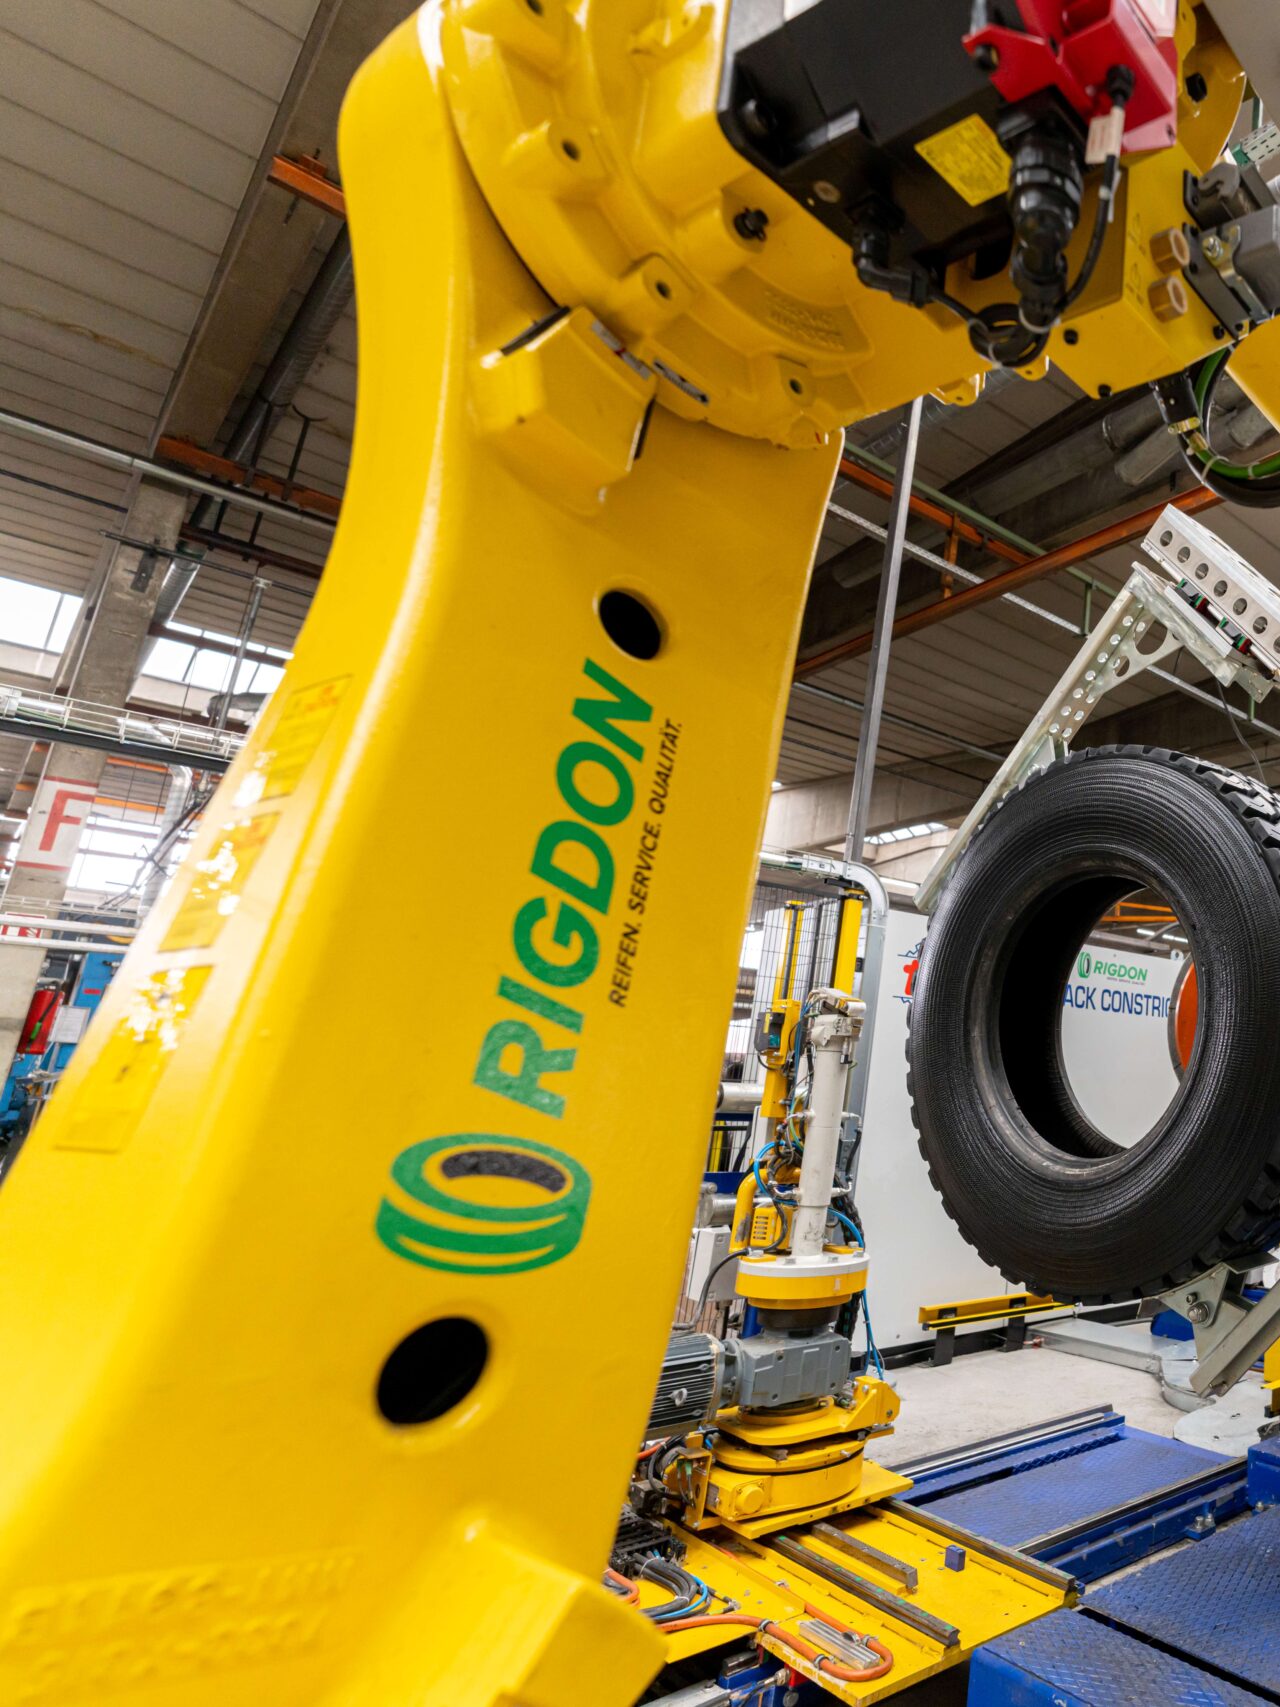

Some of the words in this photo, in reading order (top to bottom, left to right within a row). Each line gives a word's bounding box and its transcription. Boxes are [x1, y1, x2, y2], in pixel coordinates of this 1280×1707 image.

[38, 789, 96, 852] F
[472, 657, 654, 1120] RIGDON
[608, 922, 643, 1008] REIFEN.
[628, 821, 662, 915] SERVICE.
[648, 718, 683, 815] QUALITÄT.
[1093, 960, 1148, 982] RIGDON
